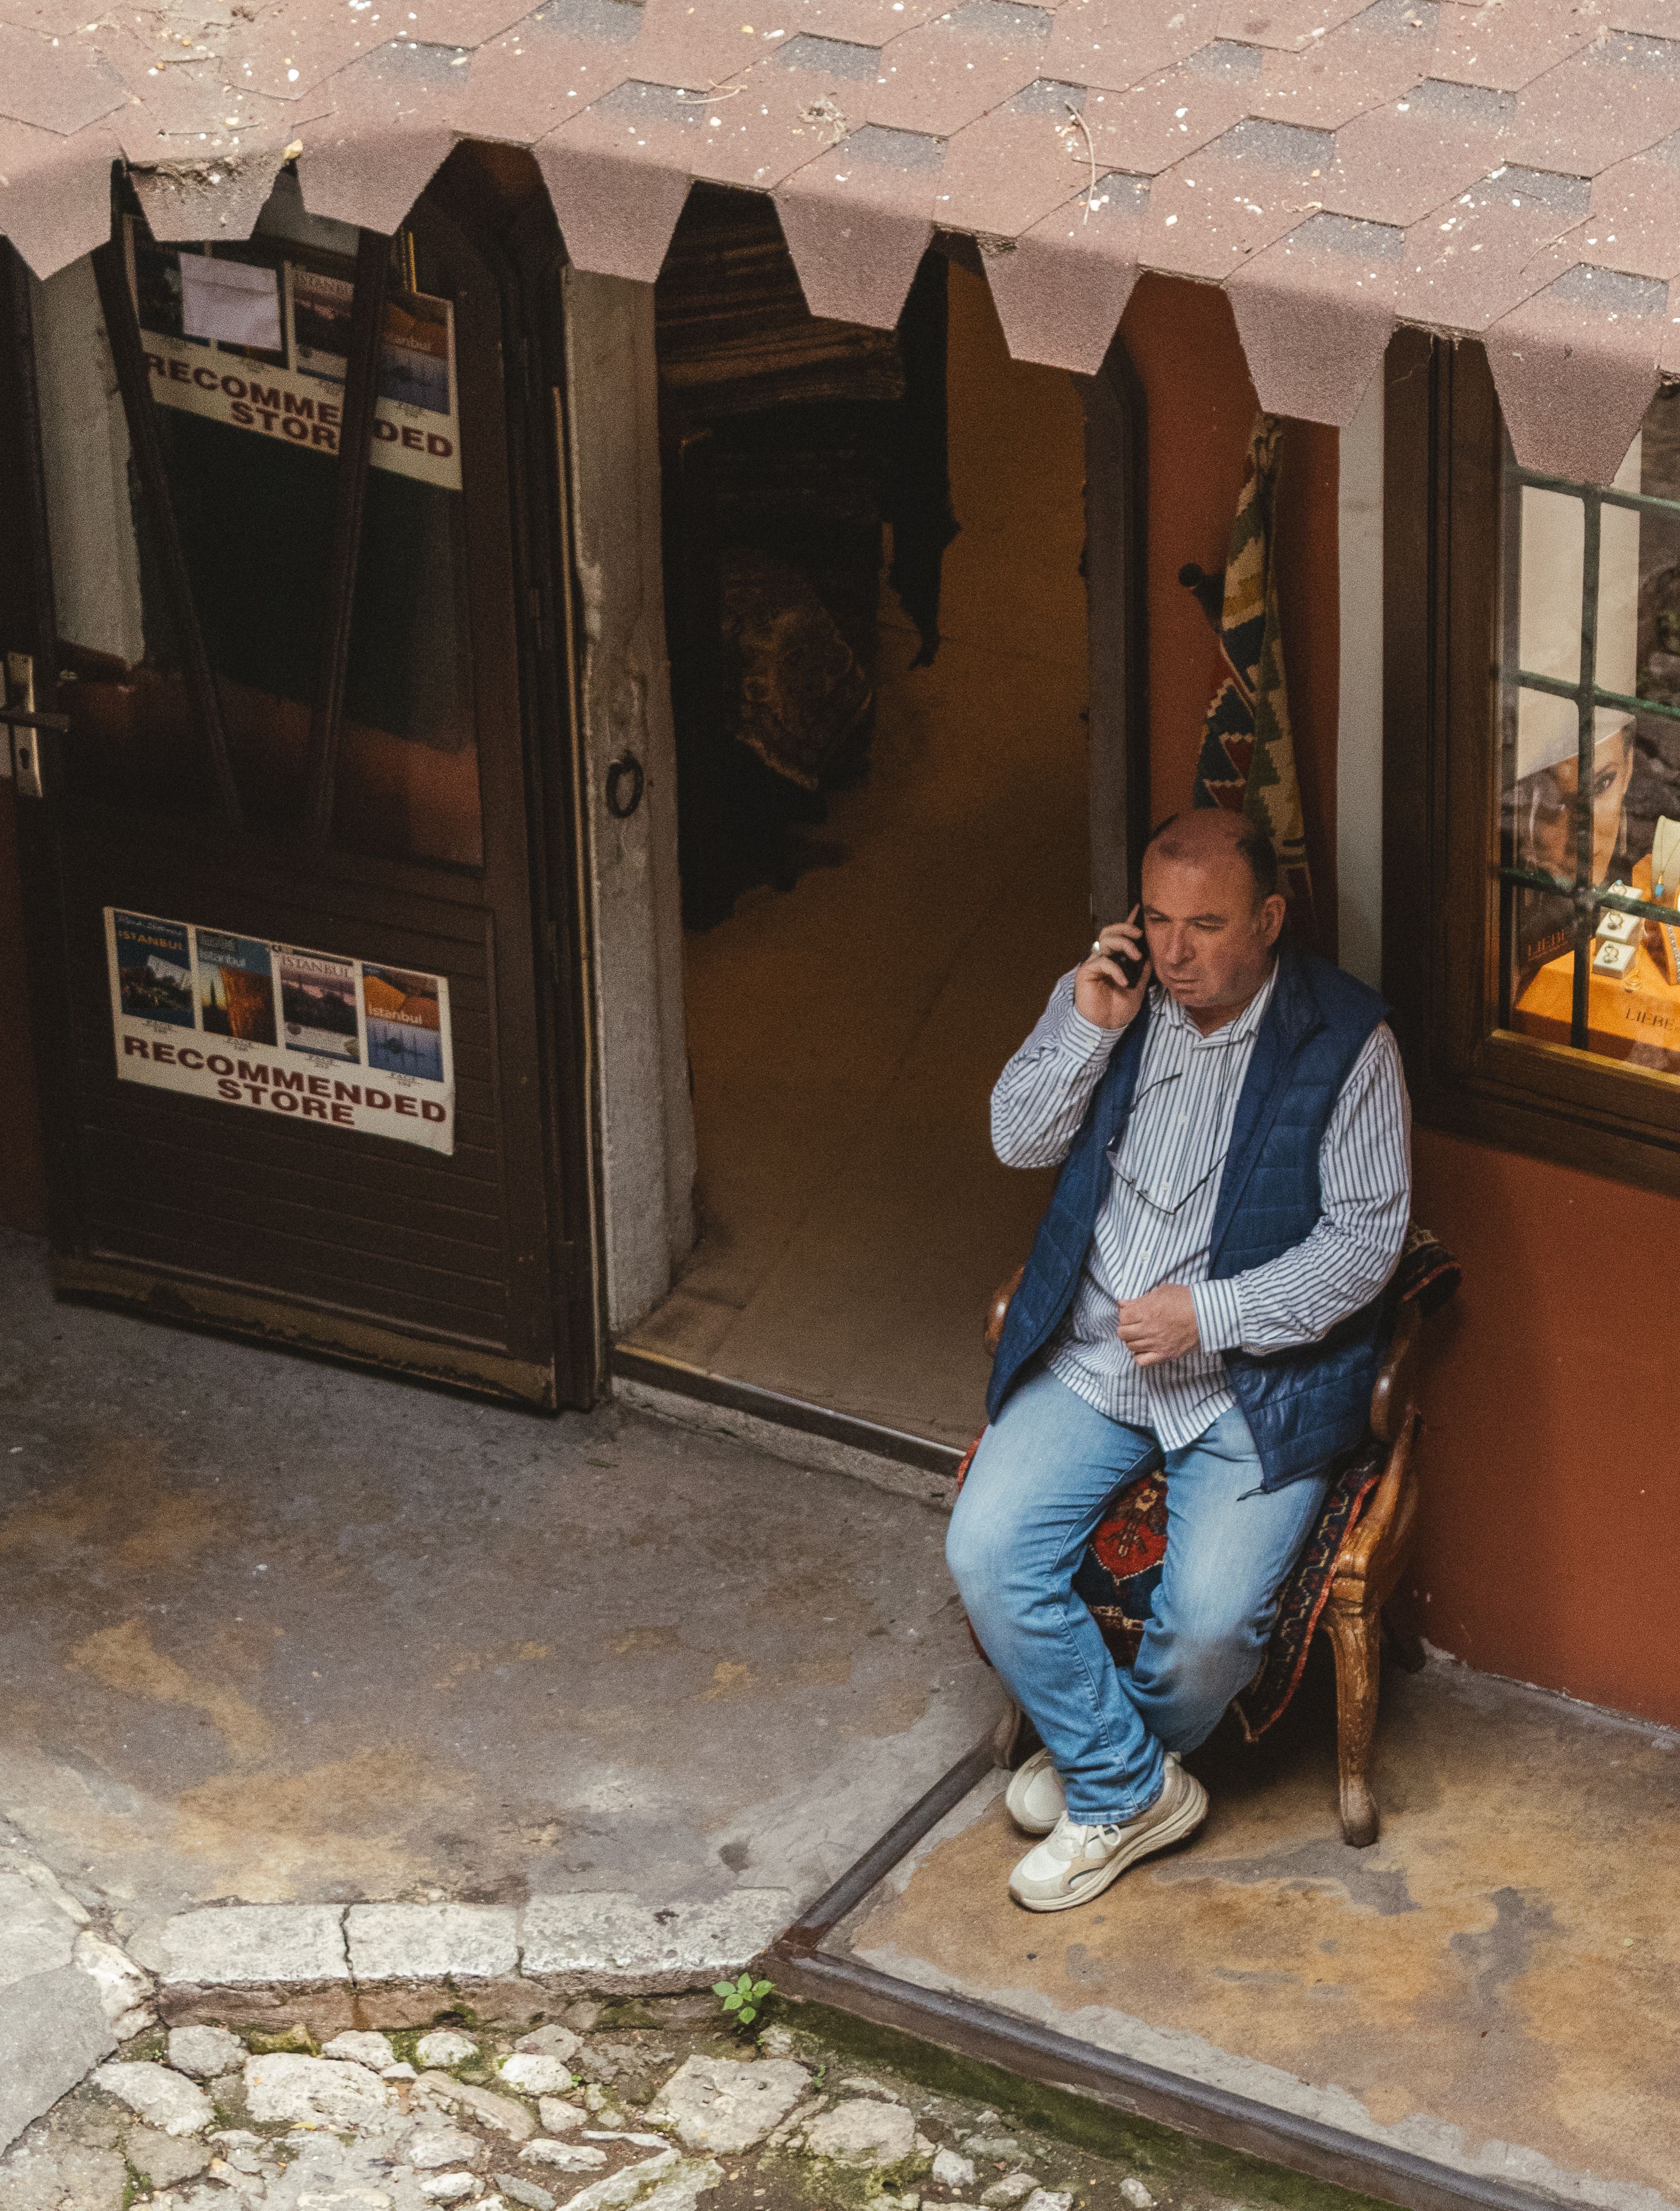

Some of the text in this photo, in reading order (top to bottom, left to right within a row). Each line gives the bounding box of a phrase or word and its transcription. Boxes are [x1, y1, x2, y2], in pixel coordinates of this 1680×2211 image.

[145, 353, 454, 458] RECOMMEDED
[230, 401, 340, 450] STOR
[118, 930, 183, 951] ISTANBUL
[282, 956, 350, 977] ISTANBUL
[123, 1035, 447, 1123] RECOMMENDED
[217, 1078, 355, 1125] STORE
